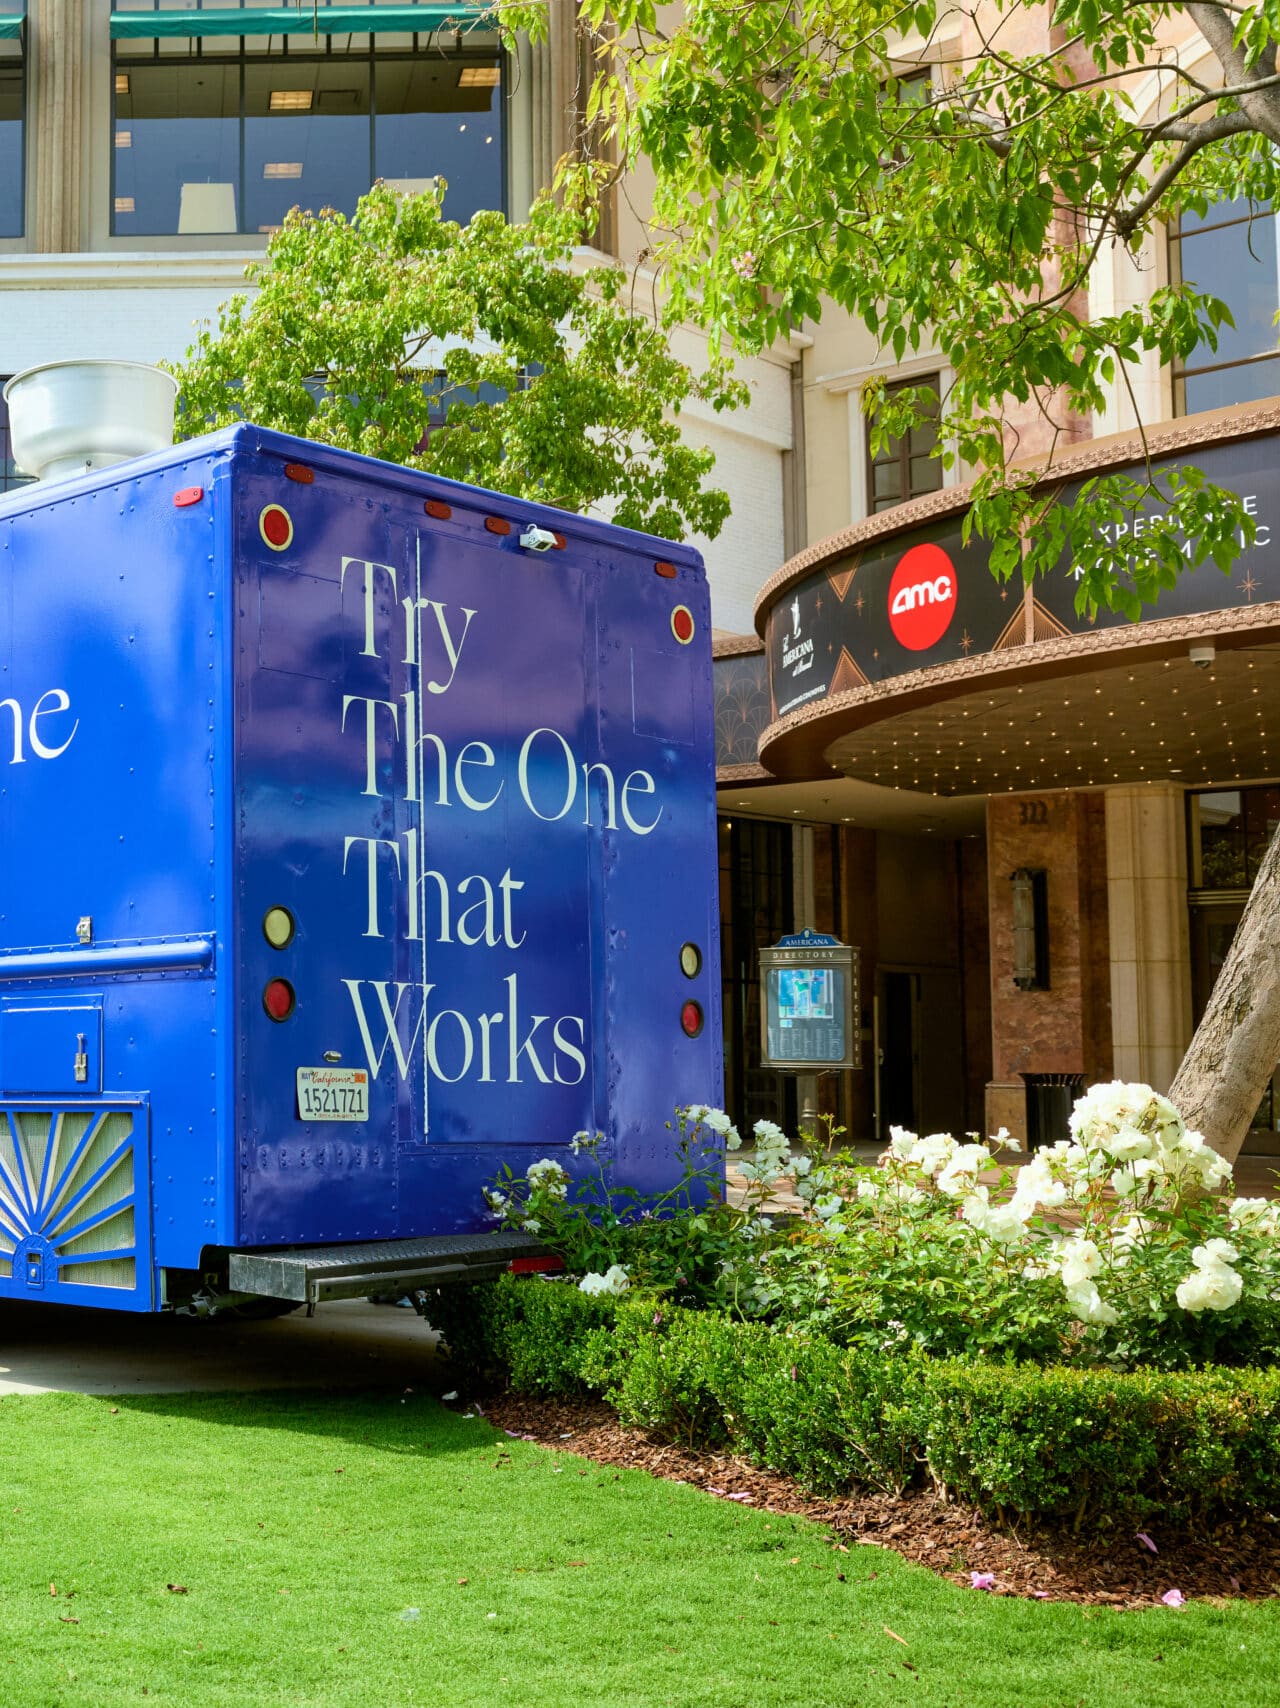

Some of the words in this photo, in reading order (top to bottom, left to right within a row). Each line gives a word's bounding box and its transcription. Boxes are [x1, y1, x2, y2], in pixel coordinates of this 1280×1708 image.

[341, 556, 478, 694] Try
[341, 690, 505, 811] The
[518, 728, 664, 835] One
[342, 829, 527, 948] That
[785, 938, 829, 946] AMERICANA
[773, 951, 834, 959] DIRECTORY
[311, 1071, 351, 1087] California
[341, 973, 586, 1086] Works
